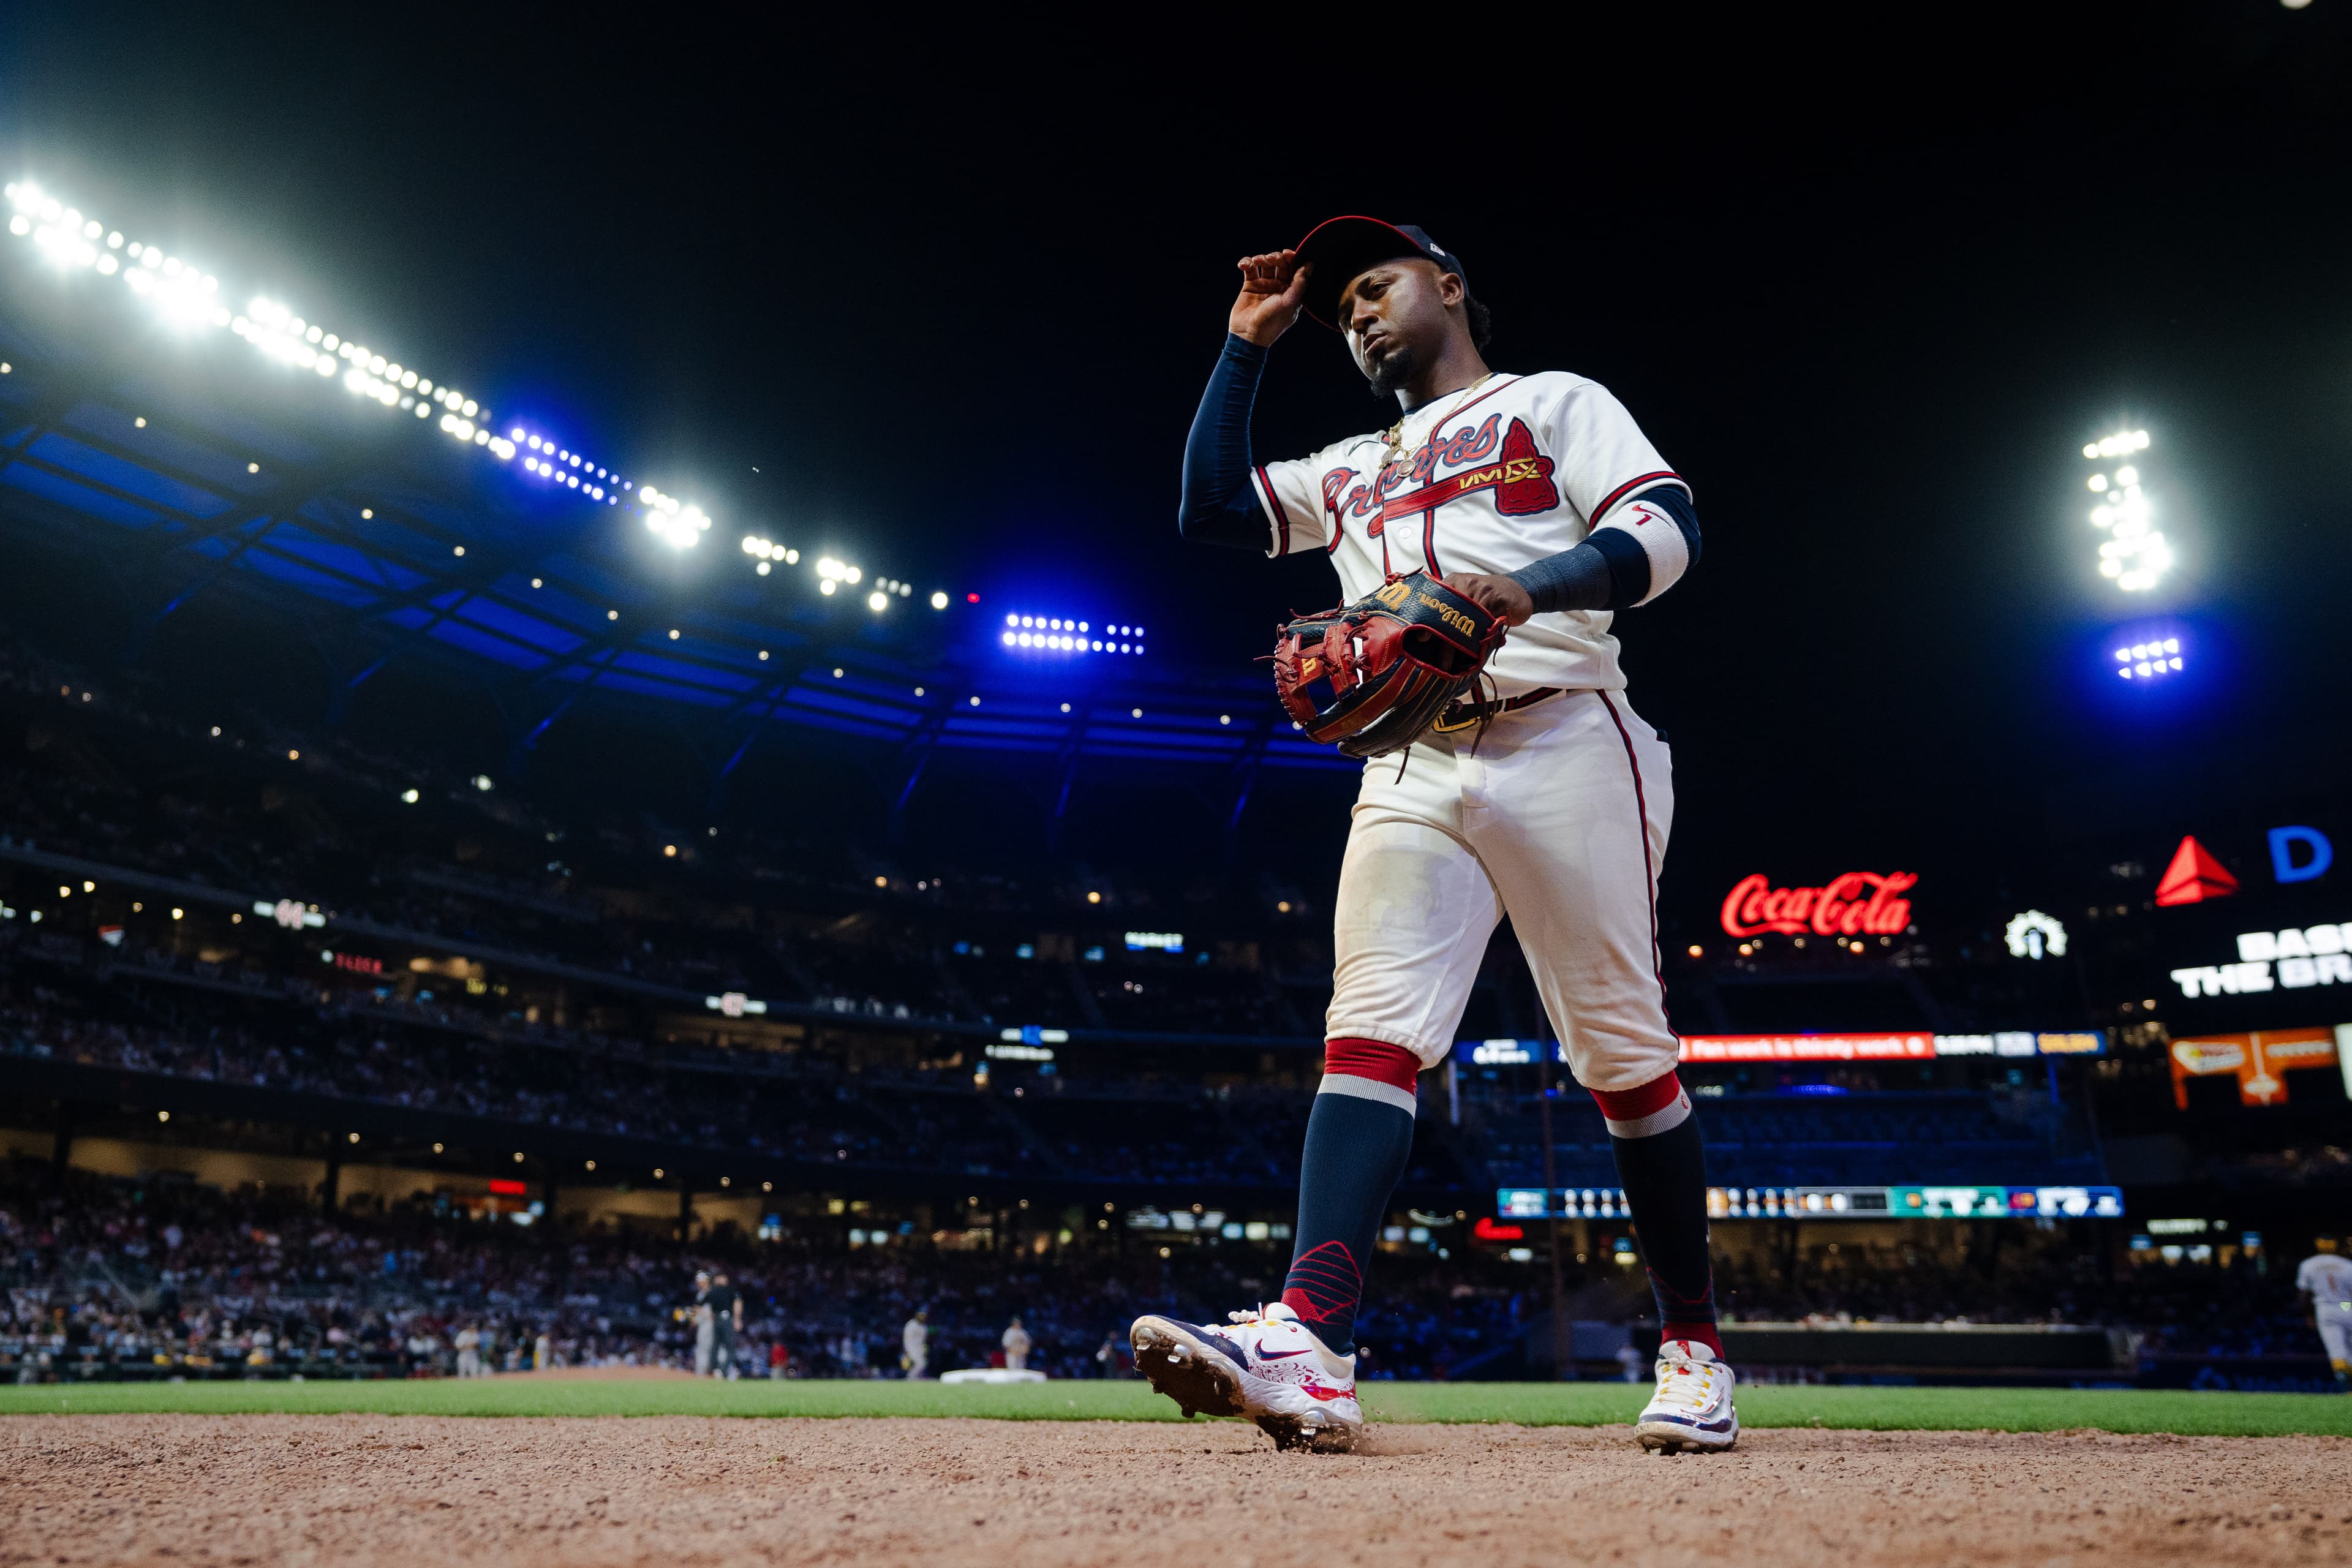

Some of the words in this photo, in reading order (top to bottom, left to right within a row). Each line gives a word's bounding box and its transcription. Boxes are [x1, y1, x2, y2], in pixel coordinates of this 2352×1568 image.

[1322, 413, 1502, 555] Braves
[1635, 514, 1653, 526] 1
[1420, 592, 1476, 638] Wilson
[2267, 825, 2334, 884] D
[2171, 961, 2274, 998] THE
